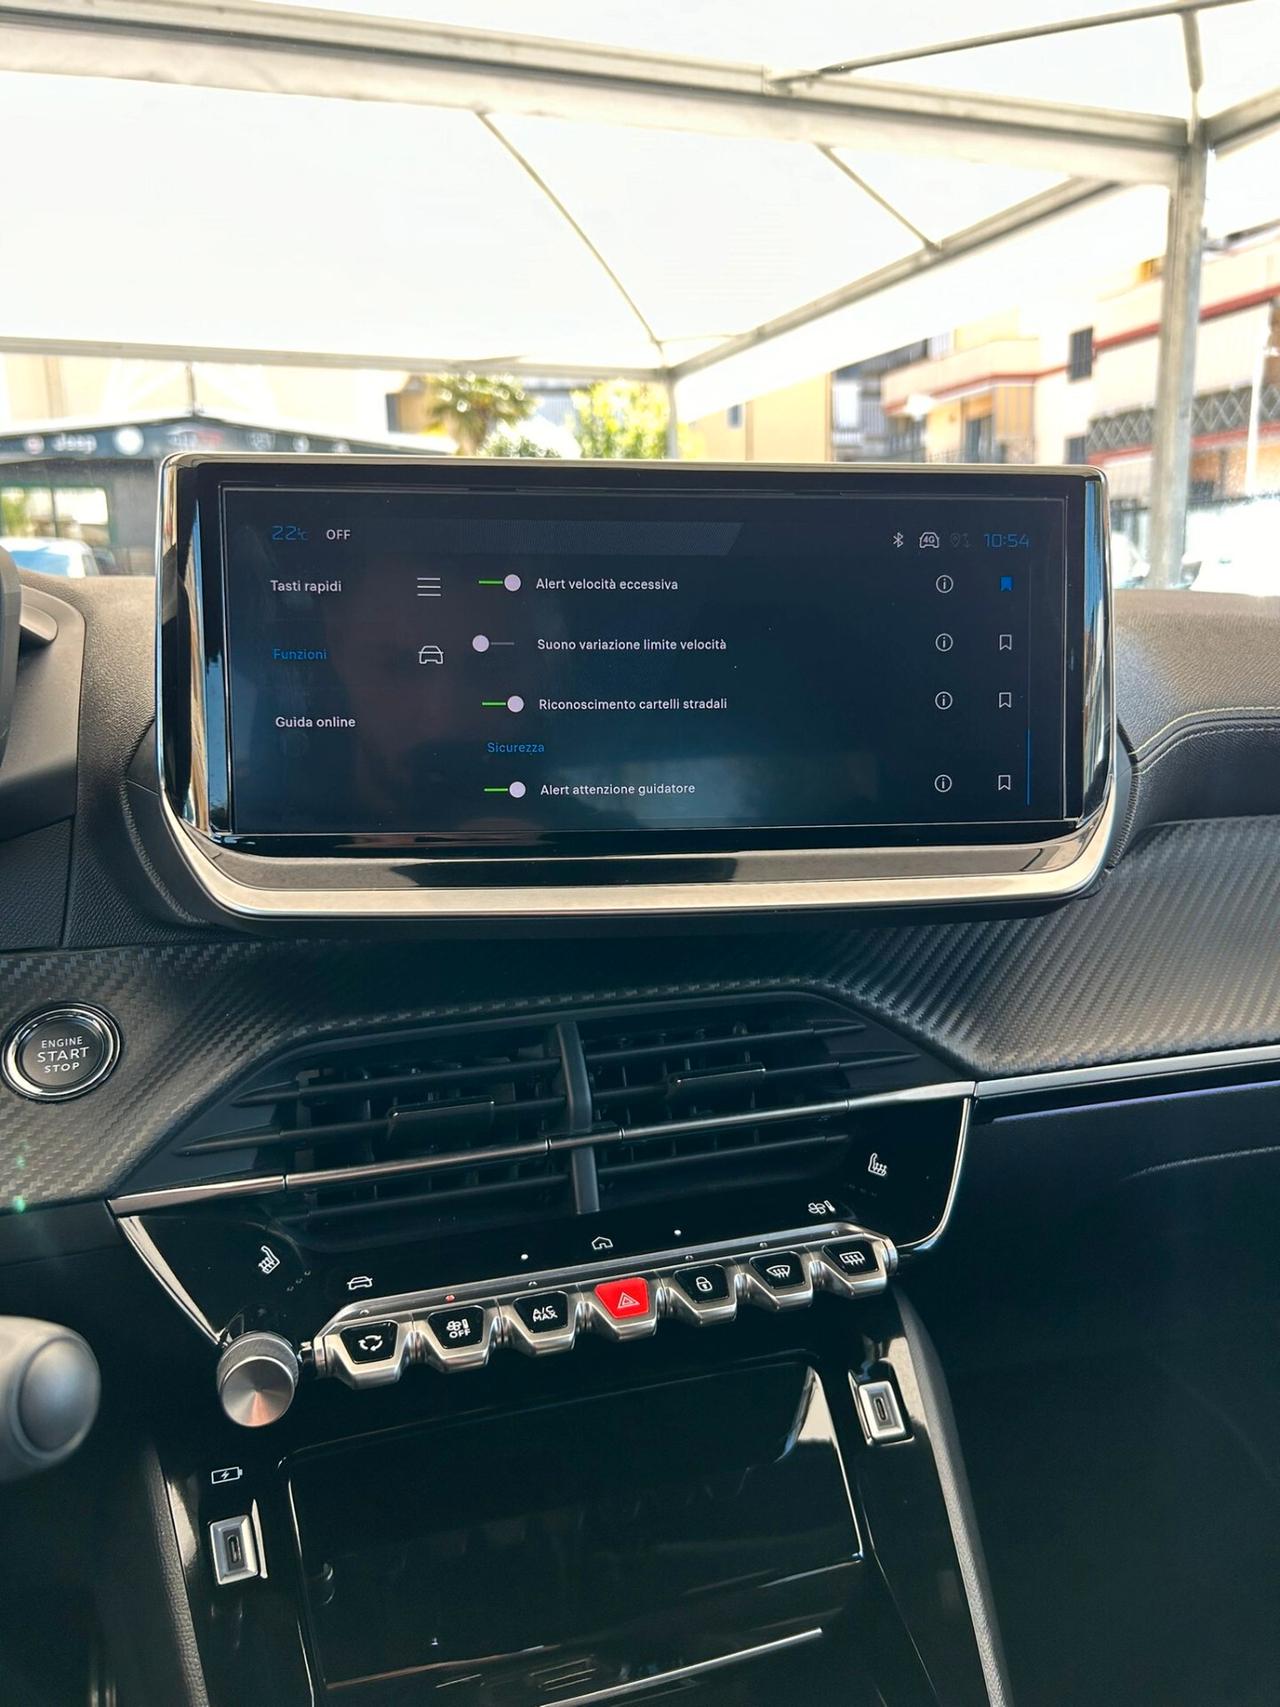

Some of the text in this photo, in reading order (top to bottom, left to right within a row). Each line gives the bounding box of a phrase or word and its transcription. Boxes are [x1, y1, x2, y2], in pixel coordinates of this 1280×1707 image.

[326, 529, 351, 540] OFF
[984, 533, 1030, 548] 10:54
[270, 580, 342, 594] Tasti rapidi
[536, 577, 679, 591] Alert velocità eccessiva
[537, 638, 727, 651] Suono variazione limite velocità
[273, 648, 328, 661] Funzioni
[539, 698, 728, 711] Riconoscimento cartelli stradali
[275, 716, 356, 728] Guida online
[487, 741, 545, 753] Sicurezza
[540, 782, 695, 796] Alert attenzione guidatore
[41, 1036, 83, 1049] ENGINE
[37, 1046, 90, 1063] START
[44, 1061, 80, 1073] STOP
[532, 1310, 558, 1322] MAX
[533, 1305, 554, 1316] A/C
[449, 1329, 471, 1339] OFF
